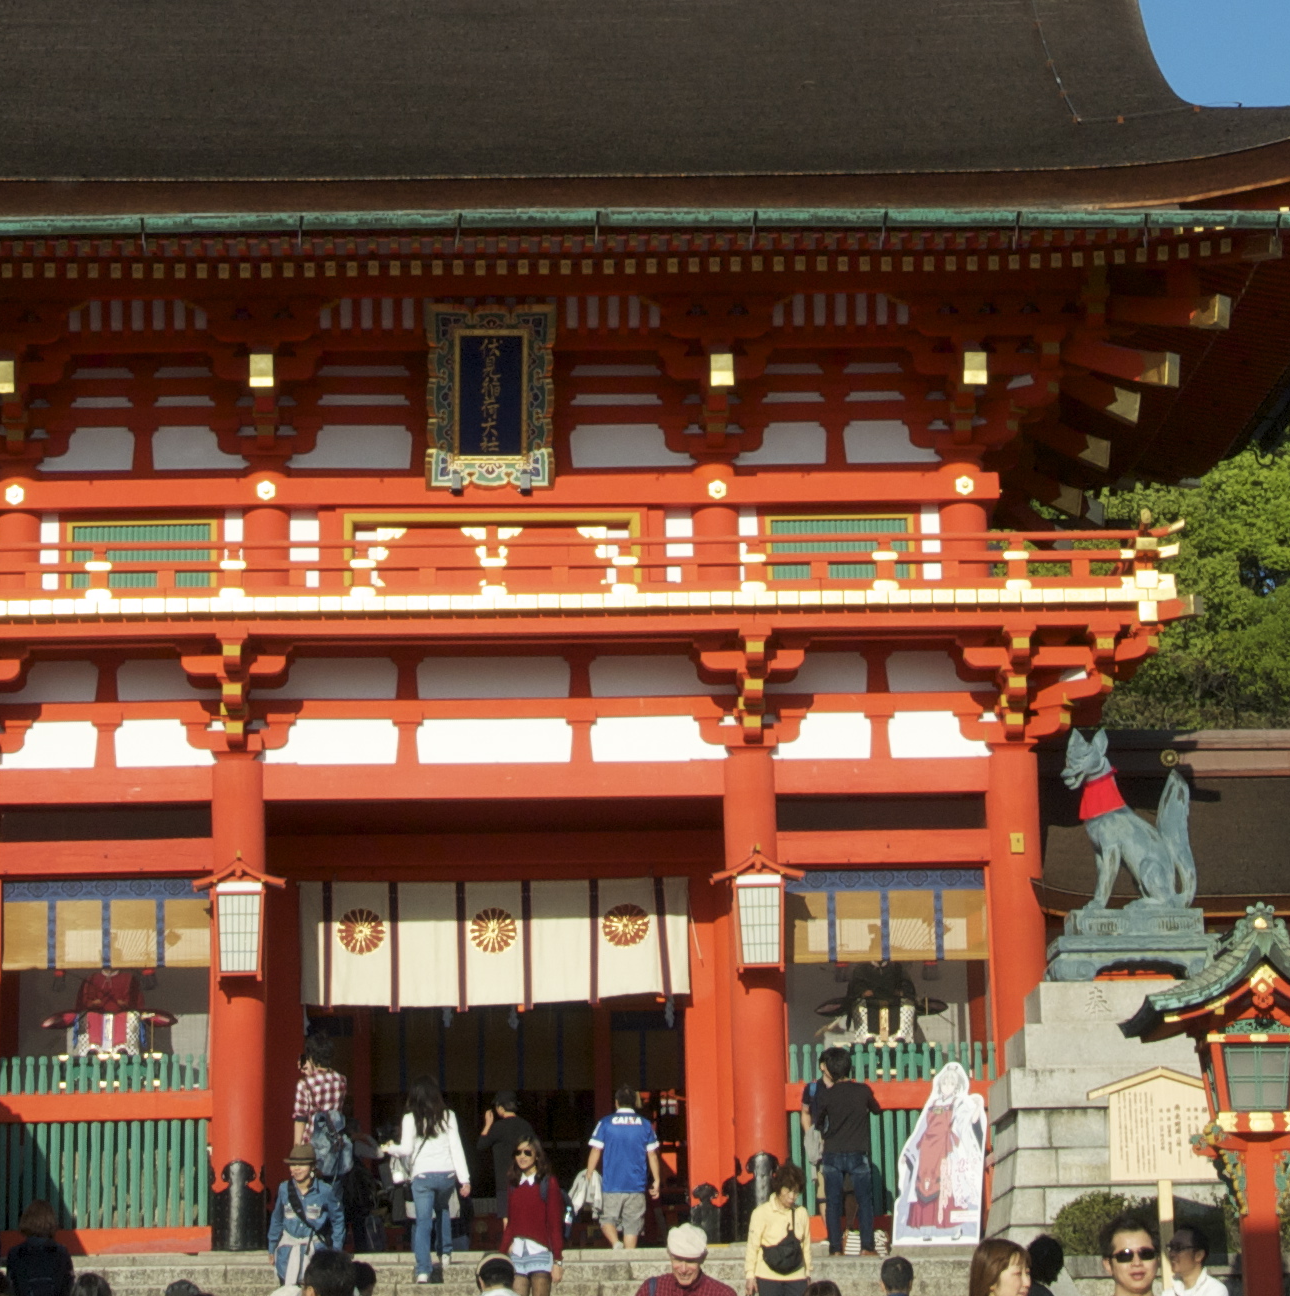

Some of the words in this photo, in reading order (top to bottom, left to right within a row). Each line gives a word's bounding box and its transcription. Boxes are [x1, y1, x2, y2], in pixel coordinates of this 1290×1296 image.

[479, 338, 502, 453] 伏見稲荷大社
[1084, 986, 1112, 1018] 奉
[611, 1116, 643, 1126] CAIXA
